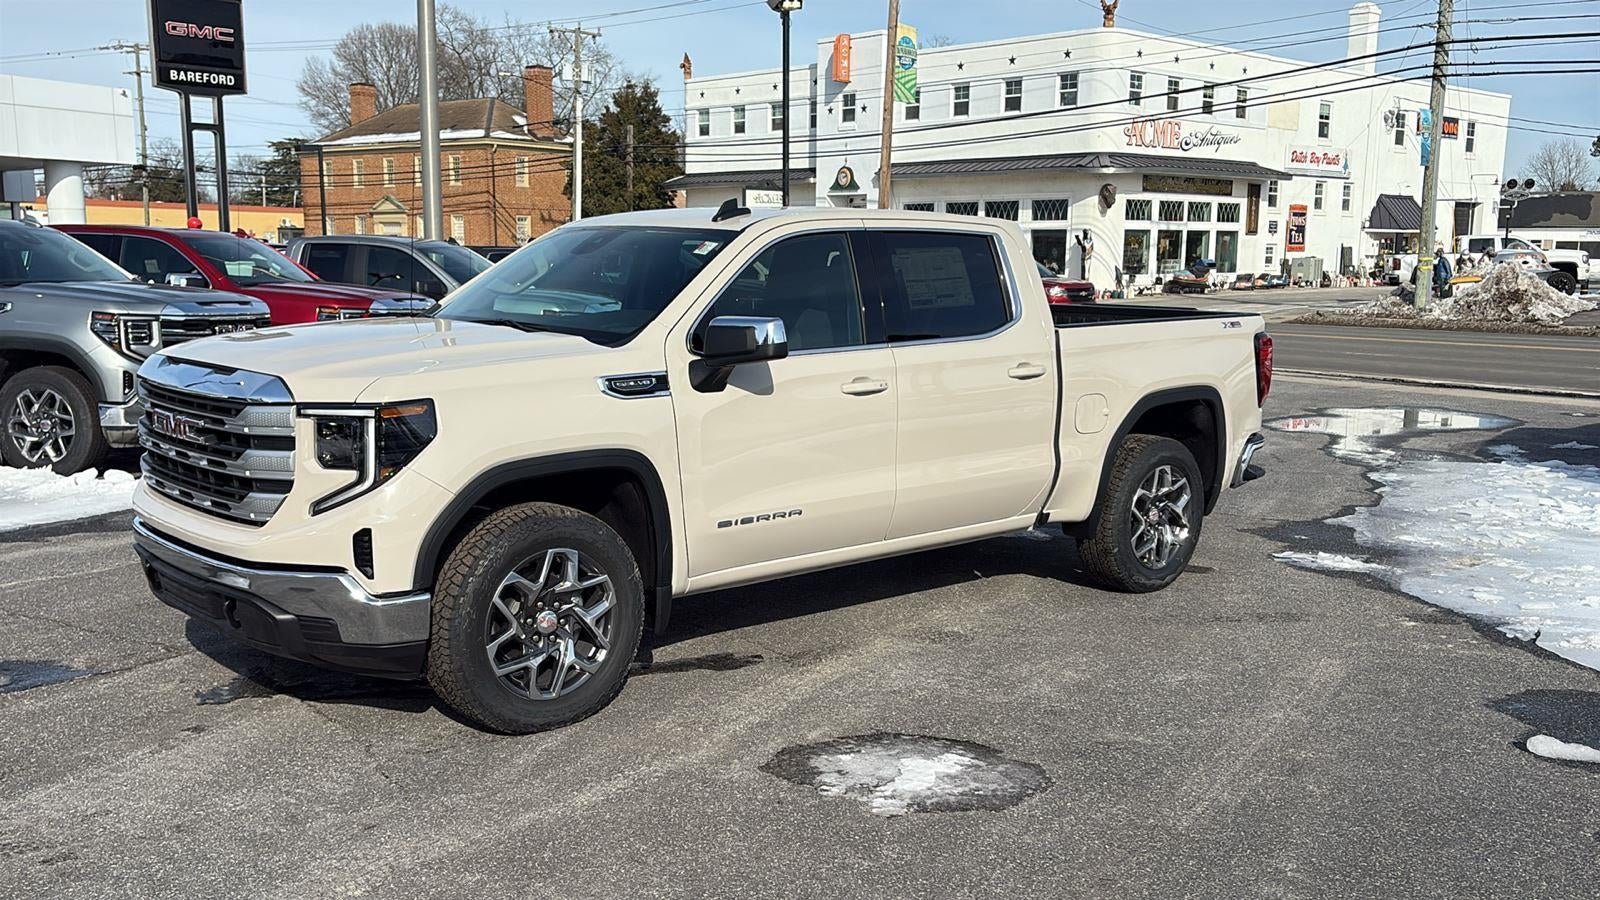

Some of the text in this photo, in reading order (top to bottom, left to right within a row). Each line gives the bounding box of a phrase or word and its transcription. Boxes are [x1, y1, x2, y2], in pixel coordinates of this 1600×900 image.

[165, 21, 234, 42] GMC
[169, 69, 235, 86] BAREFORD
[1123, 118, 1181, 150] ACME
[152, 408, 206, 445] GMC
[717, 508, 803, 529] SIERRA
